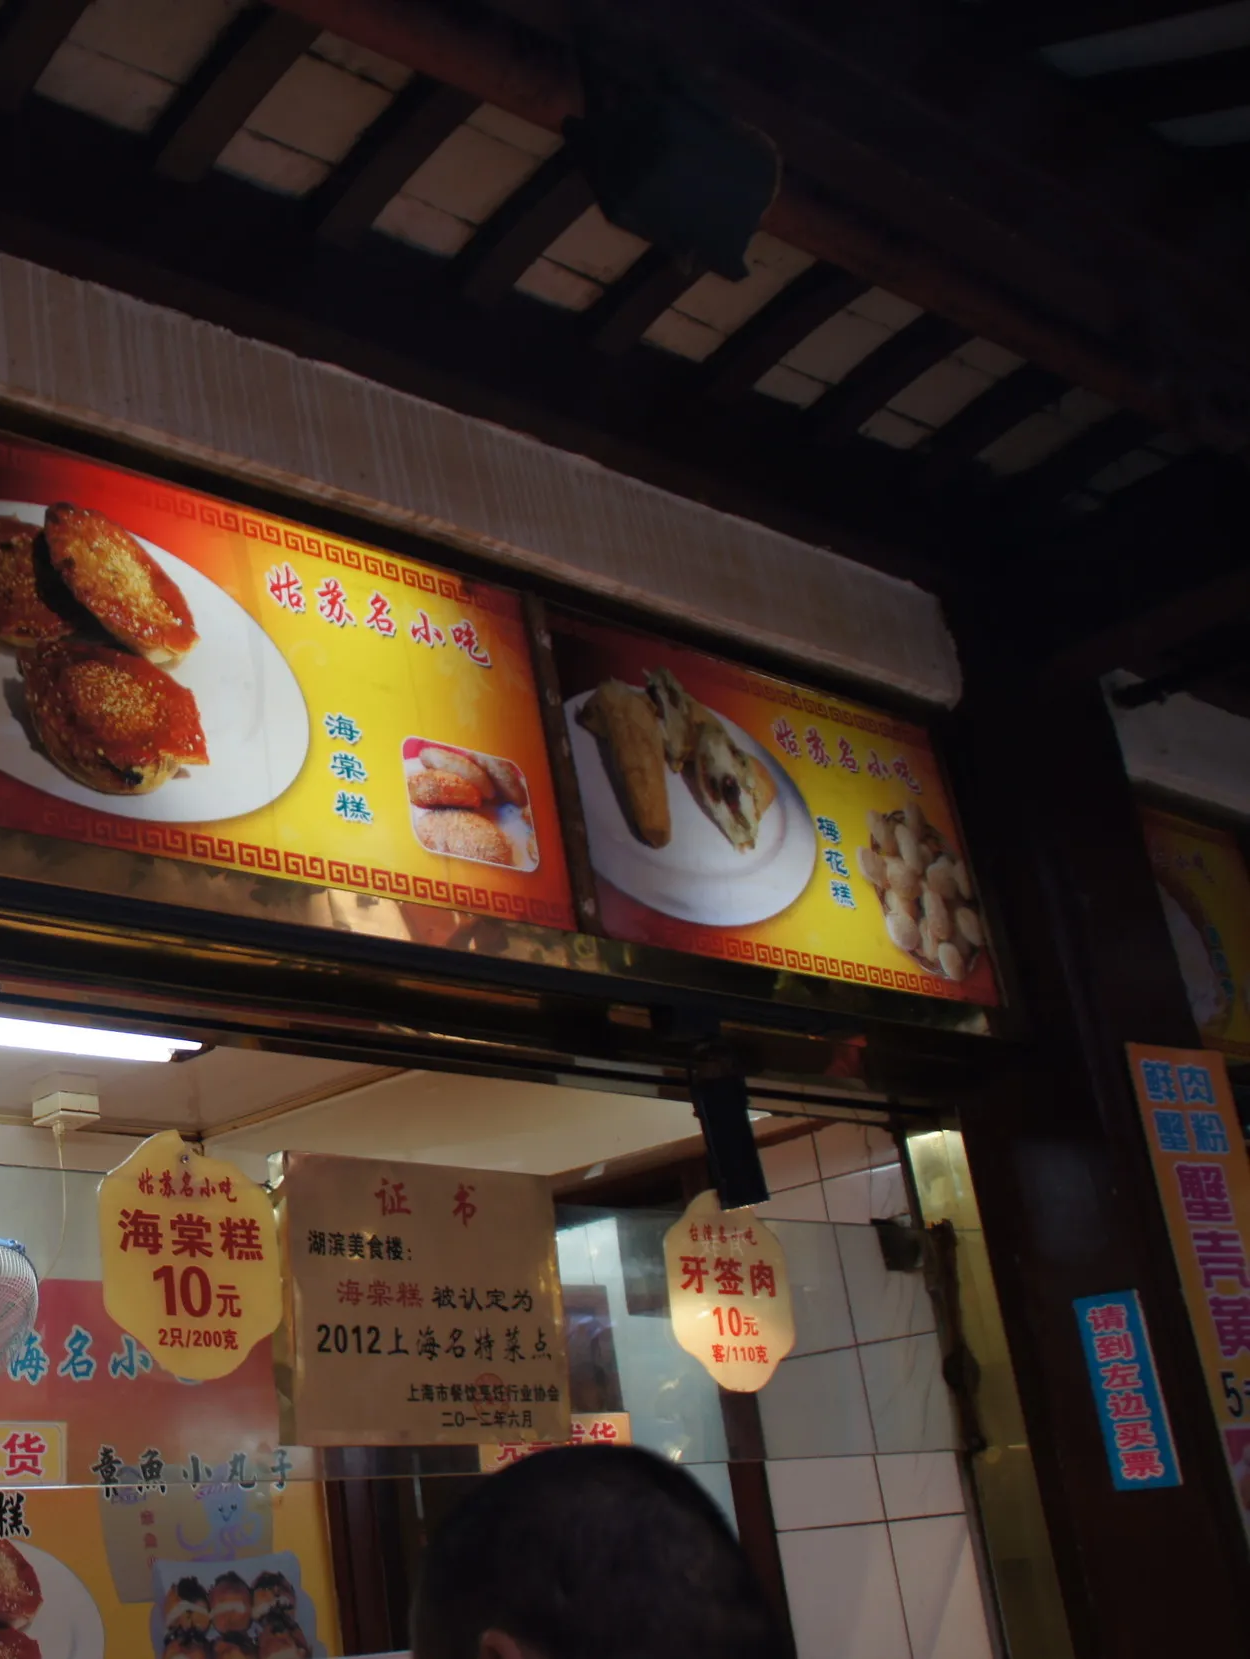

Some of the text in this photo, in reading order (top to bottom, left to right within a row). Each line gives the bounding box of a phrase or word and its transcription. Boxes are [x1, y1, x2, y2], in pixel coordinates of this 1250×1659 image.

[267, 564, 491, 667] 姑苏名小吃
[324, 713, 372, 823] 海棠糕
[772, 717, 921, 794] 姑苏名小吃
[816, 816, 856, 910] 梅花糕
[1141, 1059, 1215, 1104] 鲜肉
[1153, 1110, 1229, 1152] 蟹粉
[138, 1168, 237, 1202] 姑苏名小吃
[118, 1209, 264, 1261] 海棠糕
[153, 1265, 242, 1318] 10元
[337, 1279, 534, 1313] 海棠糕 被认定为
[679, 1255, 776, 1298] 牙签肉
[158, 1328, 238, 1350] 2只/200克
[712, 1306, 759, 1337] 10元
[712, 1344, 769, 1363] 客/110克
[1087, 1304, 1163, 1477] 请到左边买票
